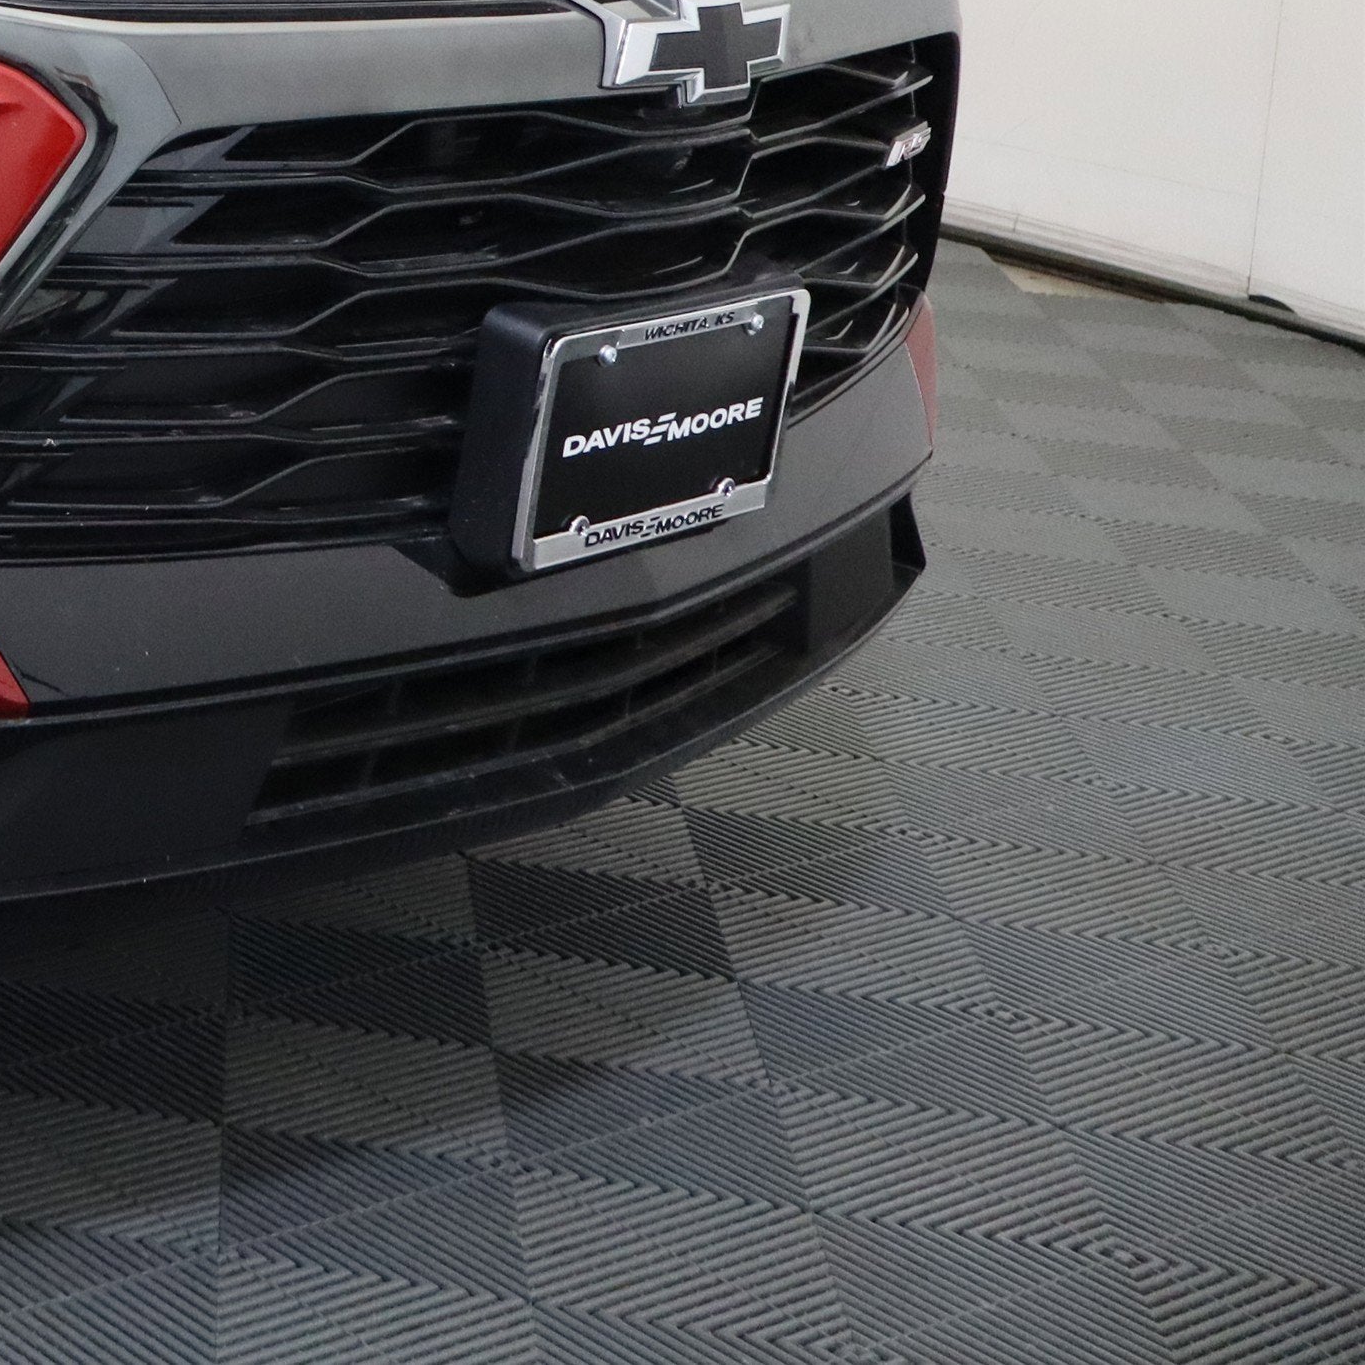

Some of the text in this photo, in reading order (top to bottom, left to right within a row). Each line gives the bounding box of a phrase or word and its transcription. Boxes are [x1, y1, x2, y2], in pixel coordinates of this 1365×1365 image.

[714, 312, 735, 326] KS
[562, 397, 764, 458] DAVIS MOORE
[584, 503, 724, 548] DAVIS MOORE
